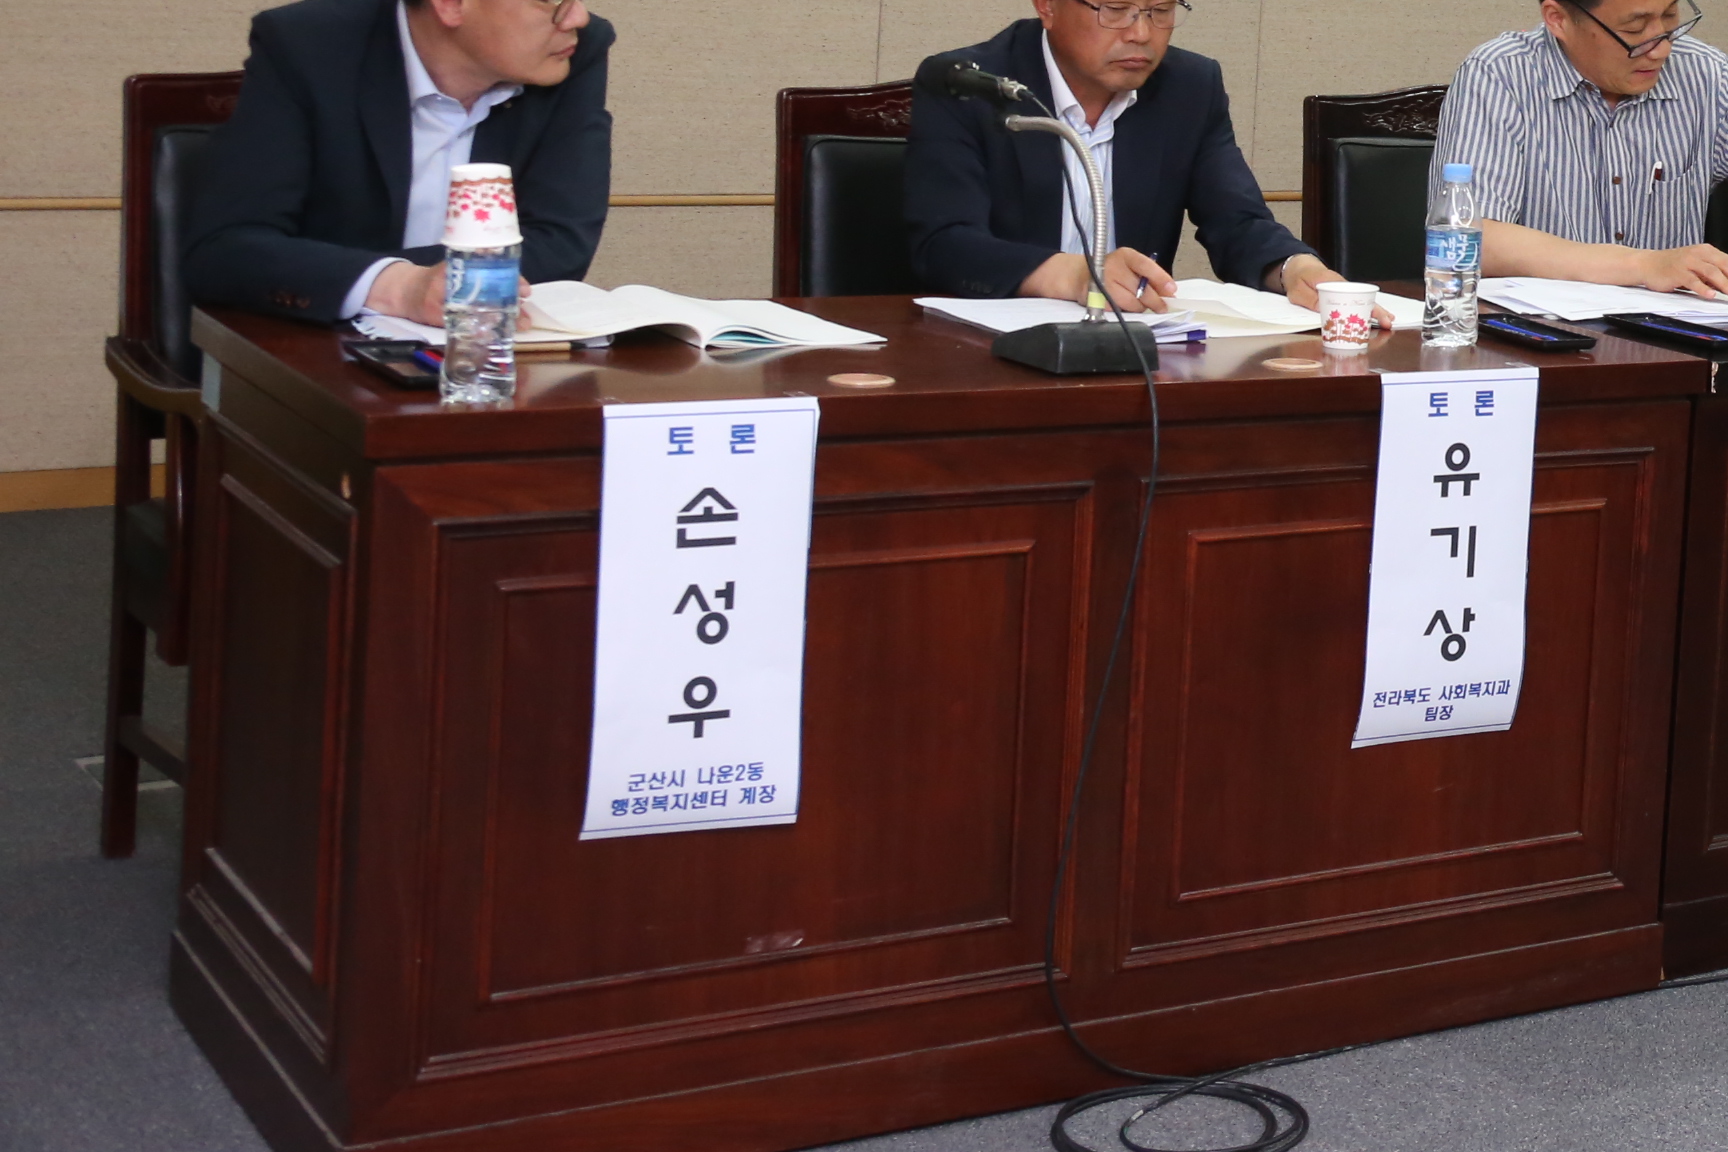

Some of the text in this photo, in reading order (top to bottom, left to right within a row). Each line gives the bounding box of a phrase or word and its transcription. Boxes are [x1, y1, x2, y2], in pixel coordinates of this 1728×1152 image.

[1372, 679, 1512, 709] 전라북도 사회복지과
[1424, 704, 1454, 722] 팀장
[627, 761, 765, 793] 군산시 나운2동
[610, 784, 777, 817] 행정복지센터 계장
